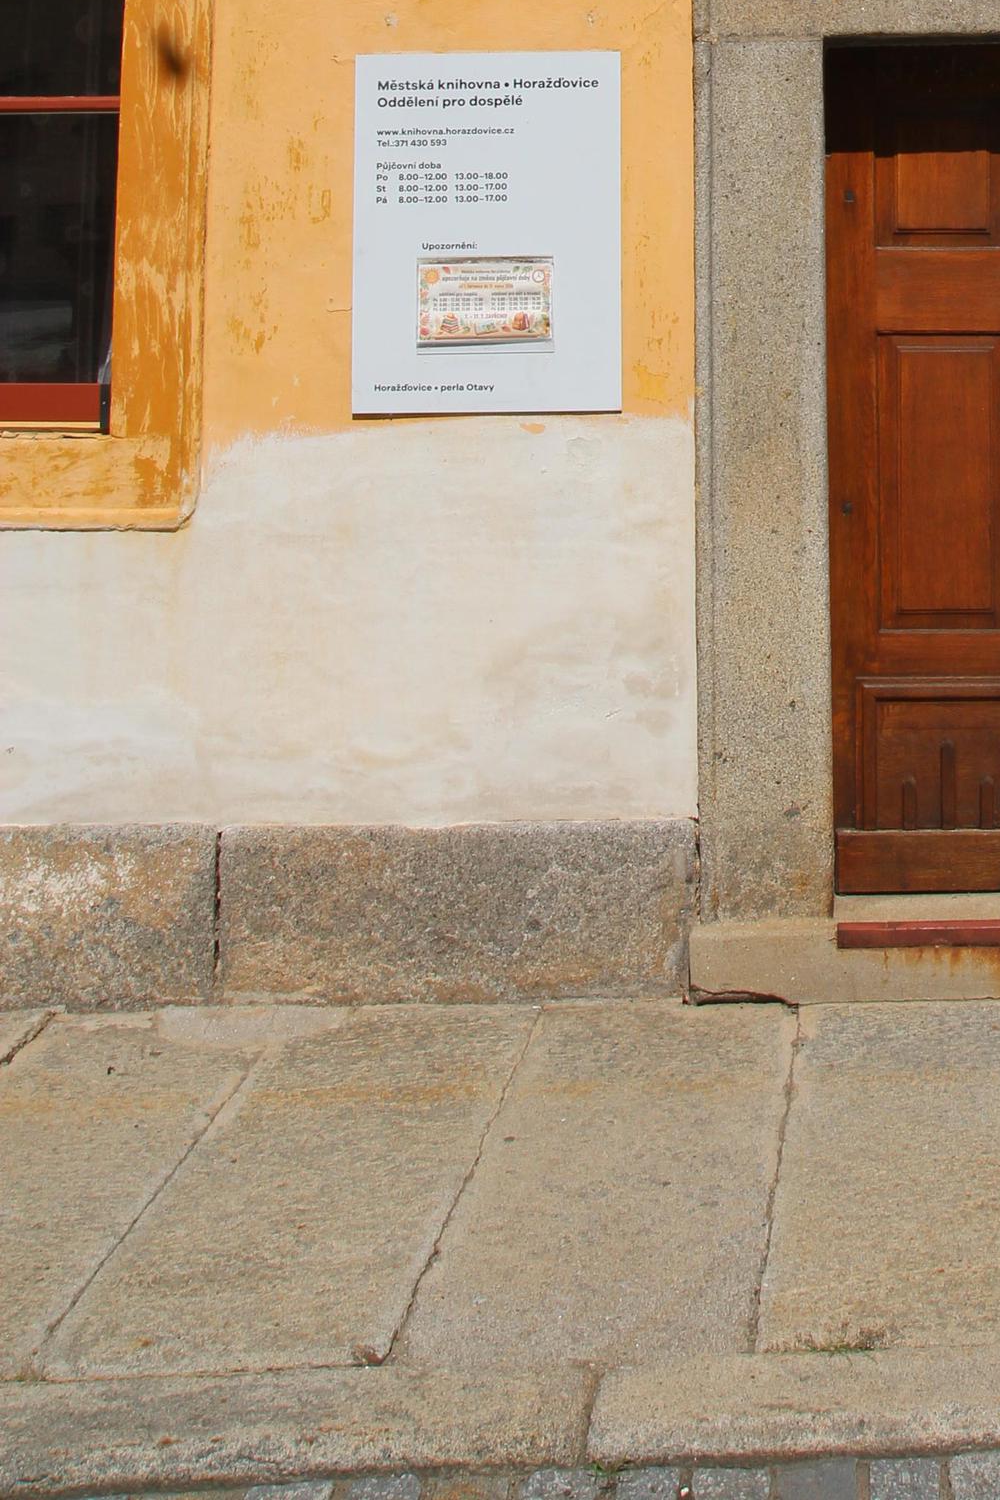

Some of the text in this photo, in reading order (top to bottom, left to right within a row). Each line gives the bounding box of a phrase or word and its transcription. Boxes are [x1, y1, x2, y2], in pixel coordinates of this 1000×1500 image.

[377, 77, 599, 91] Městská knihovna Horažďovice
[377, 95, 523, 109] Oddělení pro dospělé
[376, 127, 515, 136] www.knihovna.horazdovice.cz
[410, 139, 428, 147] 430
[430, 138, 447, 147] 593
[376, 161, 442, 171] Půjčovní doba
[376, 173, 388, 181] Po
[376, 185, 386, 193] St
[376, 195, 388, 204] Pá
[421, 241, 478, 251] Upozornění:
[440, 383, 465, 393] perla
[466, 383, 495, 393] Otavy
